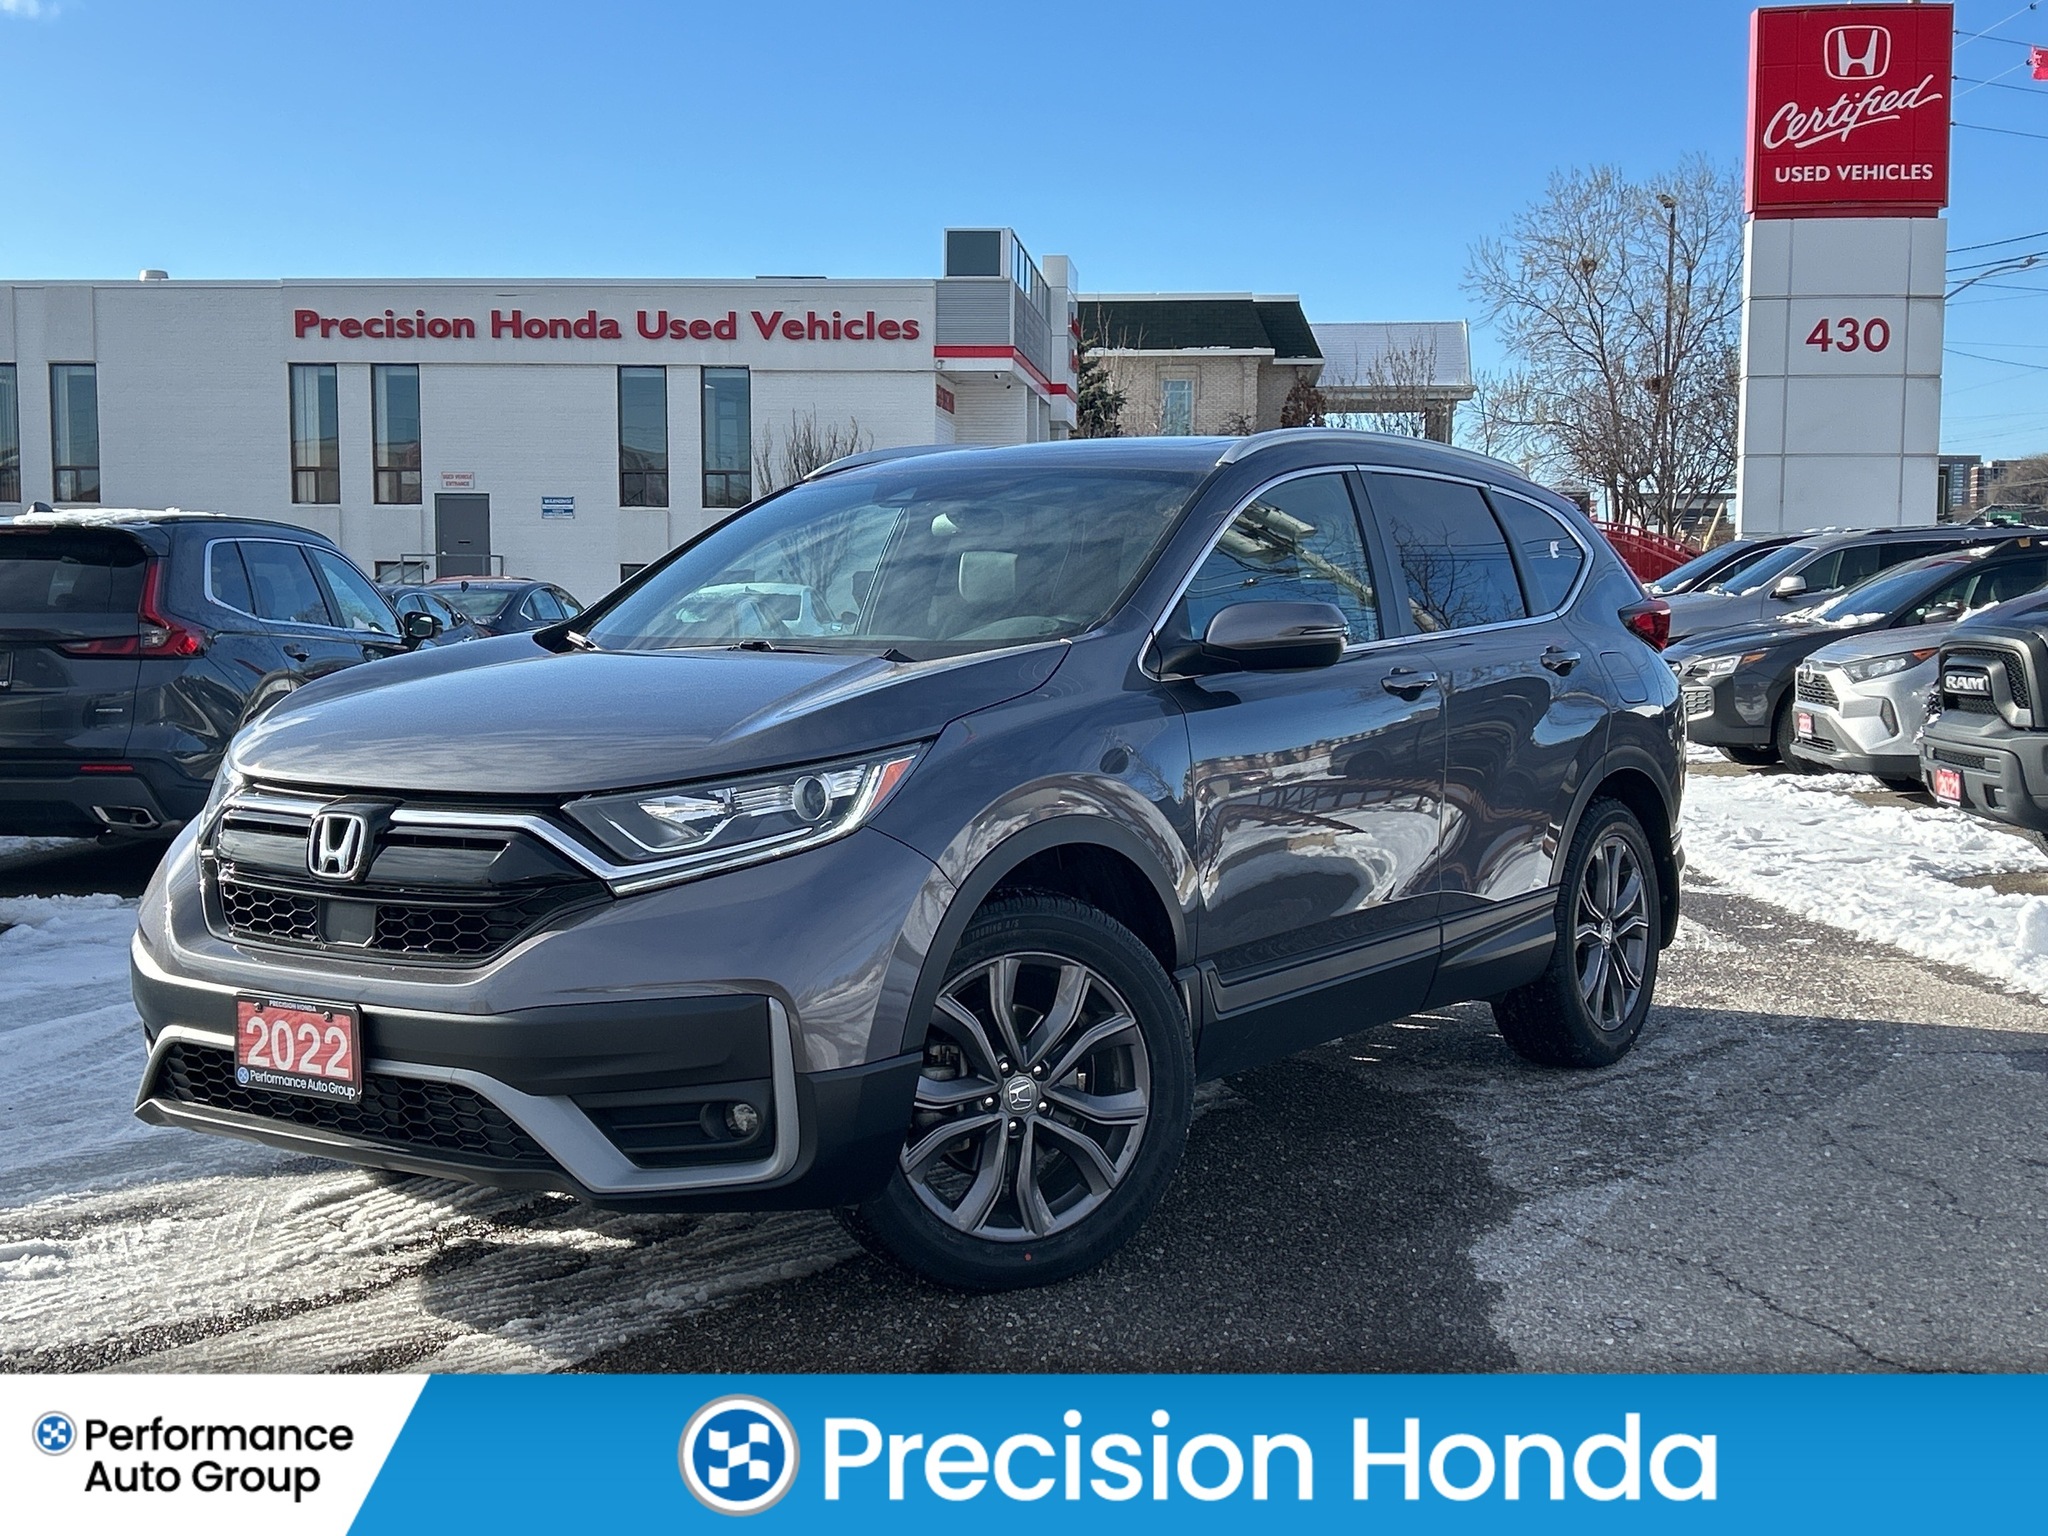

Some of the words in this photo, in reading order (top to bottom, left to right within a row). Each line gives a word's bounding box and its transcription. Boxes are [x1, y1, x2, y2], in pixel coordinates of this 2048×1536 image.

[1763, 73, 1943, 150] Certified
[1775, 165, 1831, 183] USED
[1837, 163, 1934, 181] VEHICLES
[294, 309, 475, 339] Precision
[491, 309, 622, 339] Honda
[637, 310, 737, 340] Used
[751, 310, 920, 341] Vehicles
[1805, 317, 1891, 353] 430
[1945, 675, 1986, 691] RAM
[246, 1016, 349, 1079] 2022
[250, 1070, 306, 1089] Performance
[308, 1079, 327, 1093] Auto
[328, 1081, 356, 1100] Group
